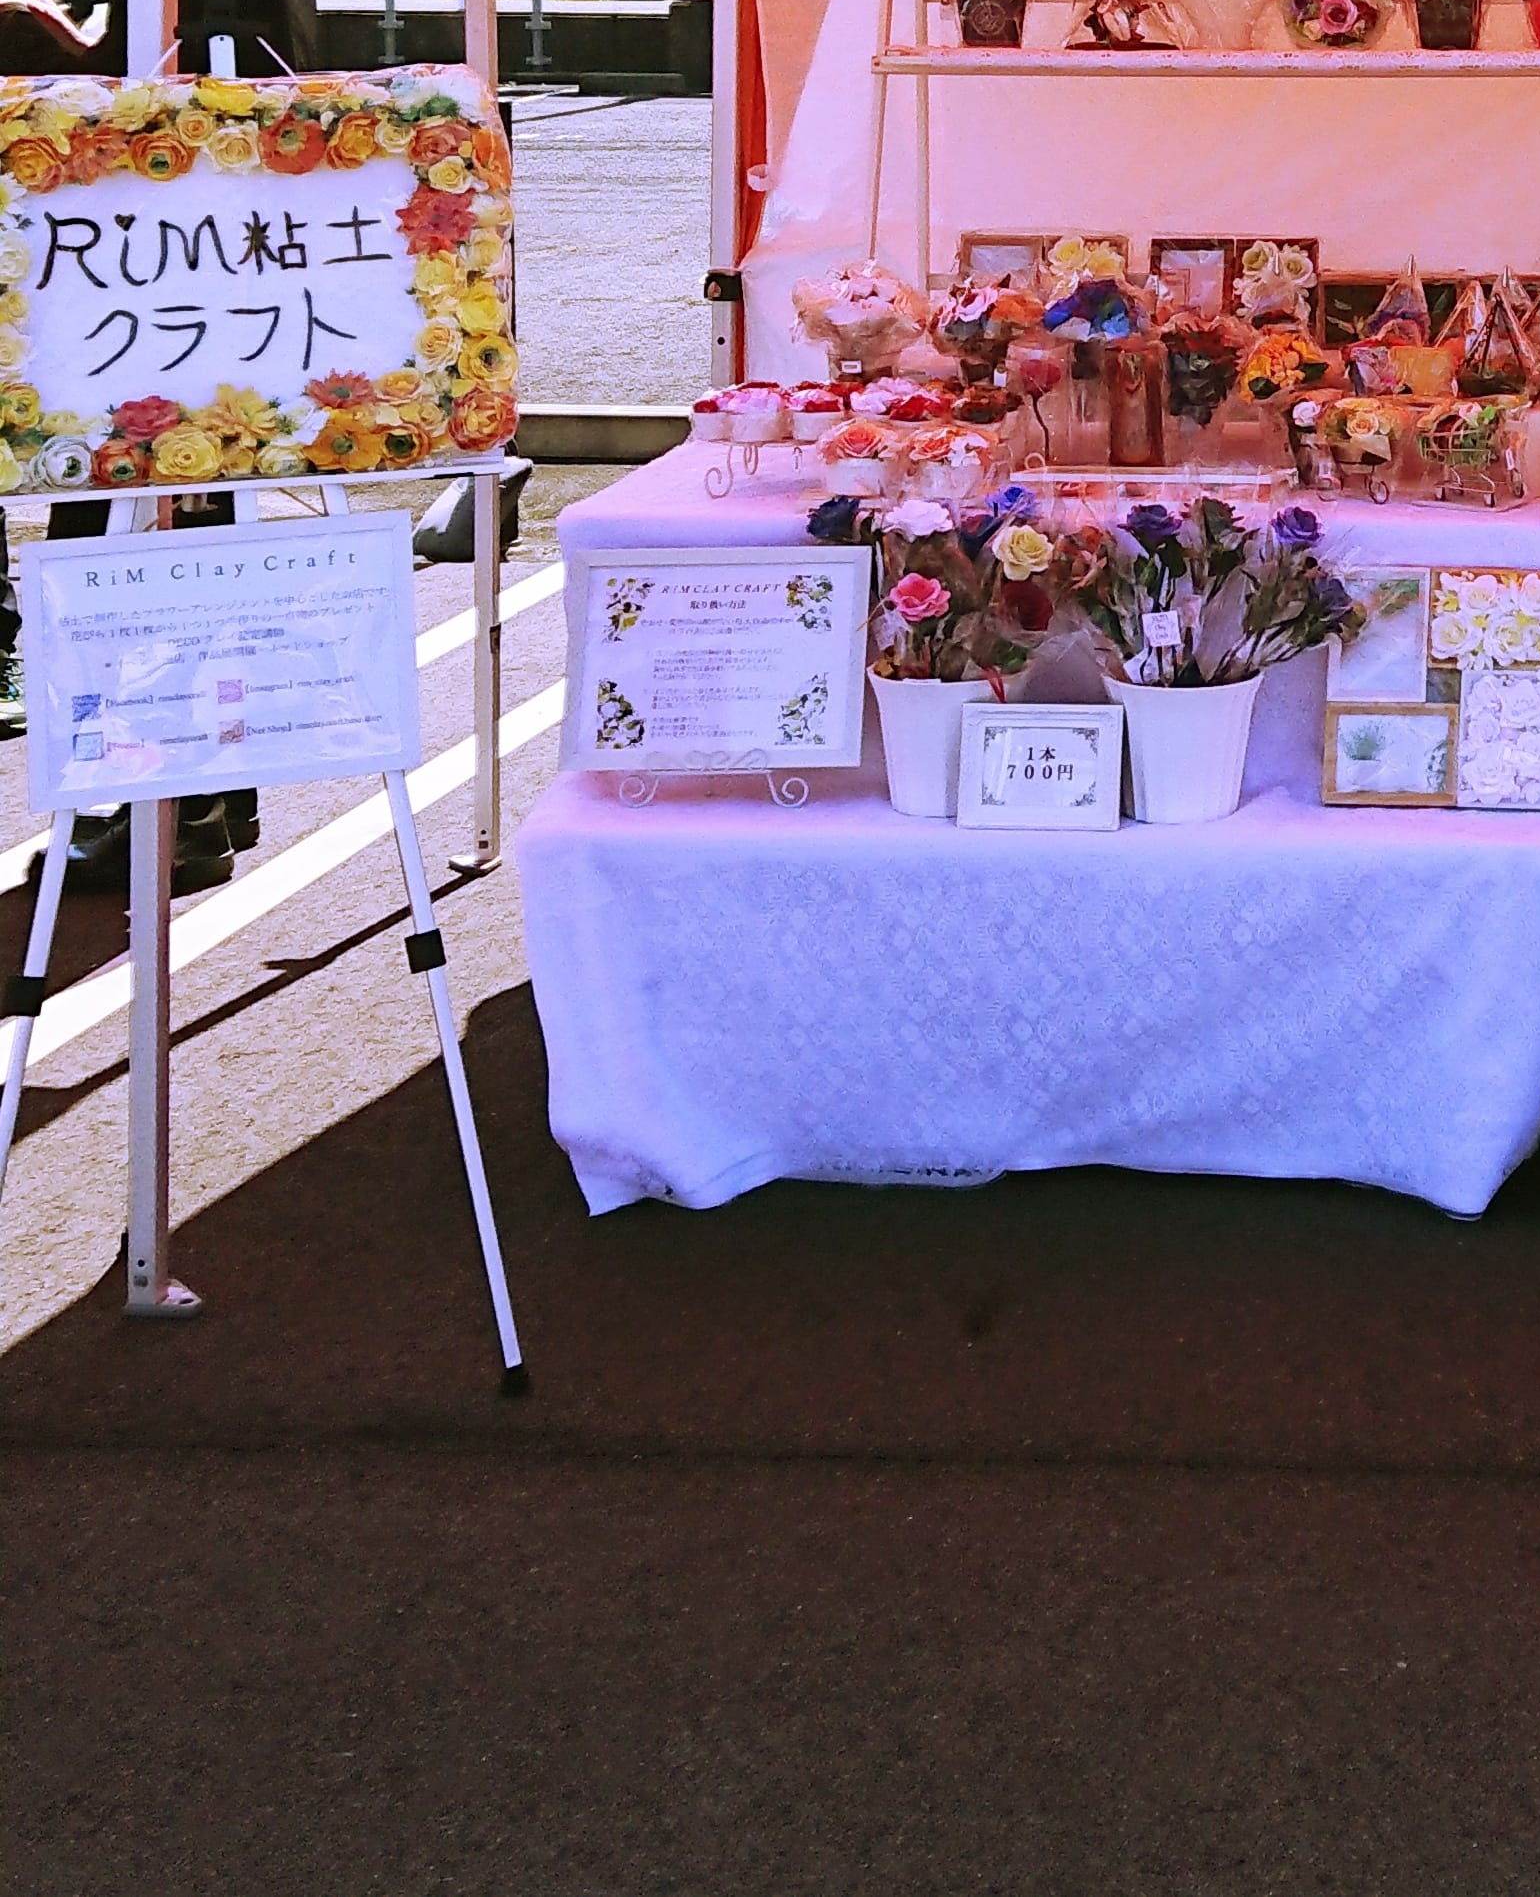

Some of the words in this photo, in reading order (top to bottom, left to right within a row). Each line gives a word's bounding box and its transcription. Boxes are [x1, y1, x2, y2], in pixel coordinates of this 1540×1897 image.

[36, 204, 393, 290] RiM粘土
[83, 287, 358, 377] クラフト
[86, 567, 146, 588] RiM
[170, 562, 245, 579] Clay
[263, 550, 356, 572] Craft
[1006, 763, 1074, 781] 700円
[1026, 746, 1057, 762] 1本
